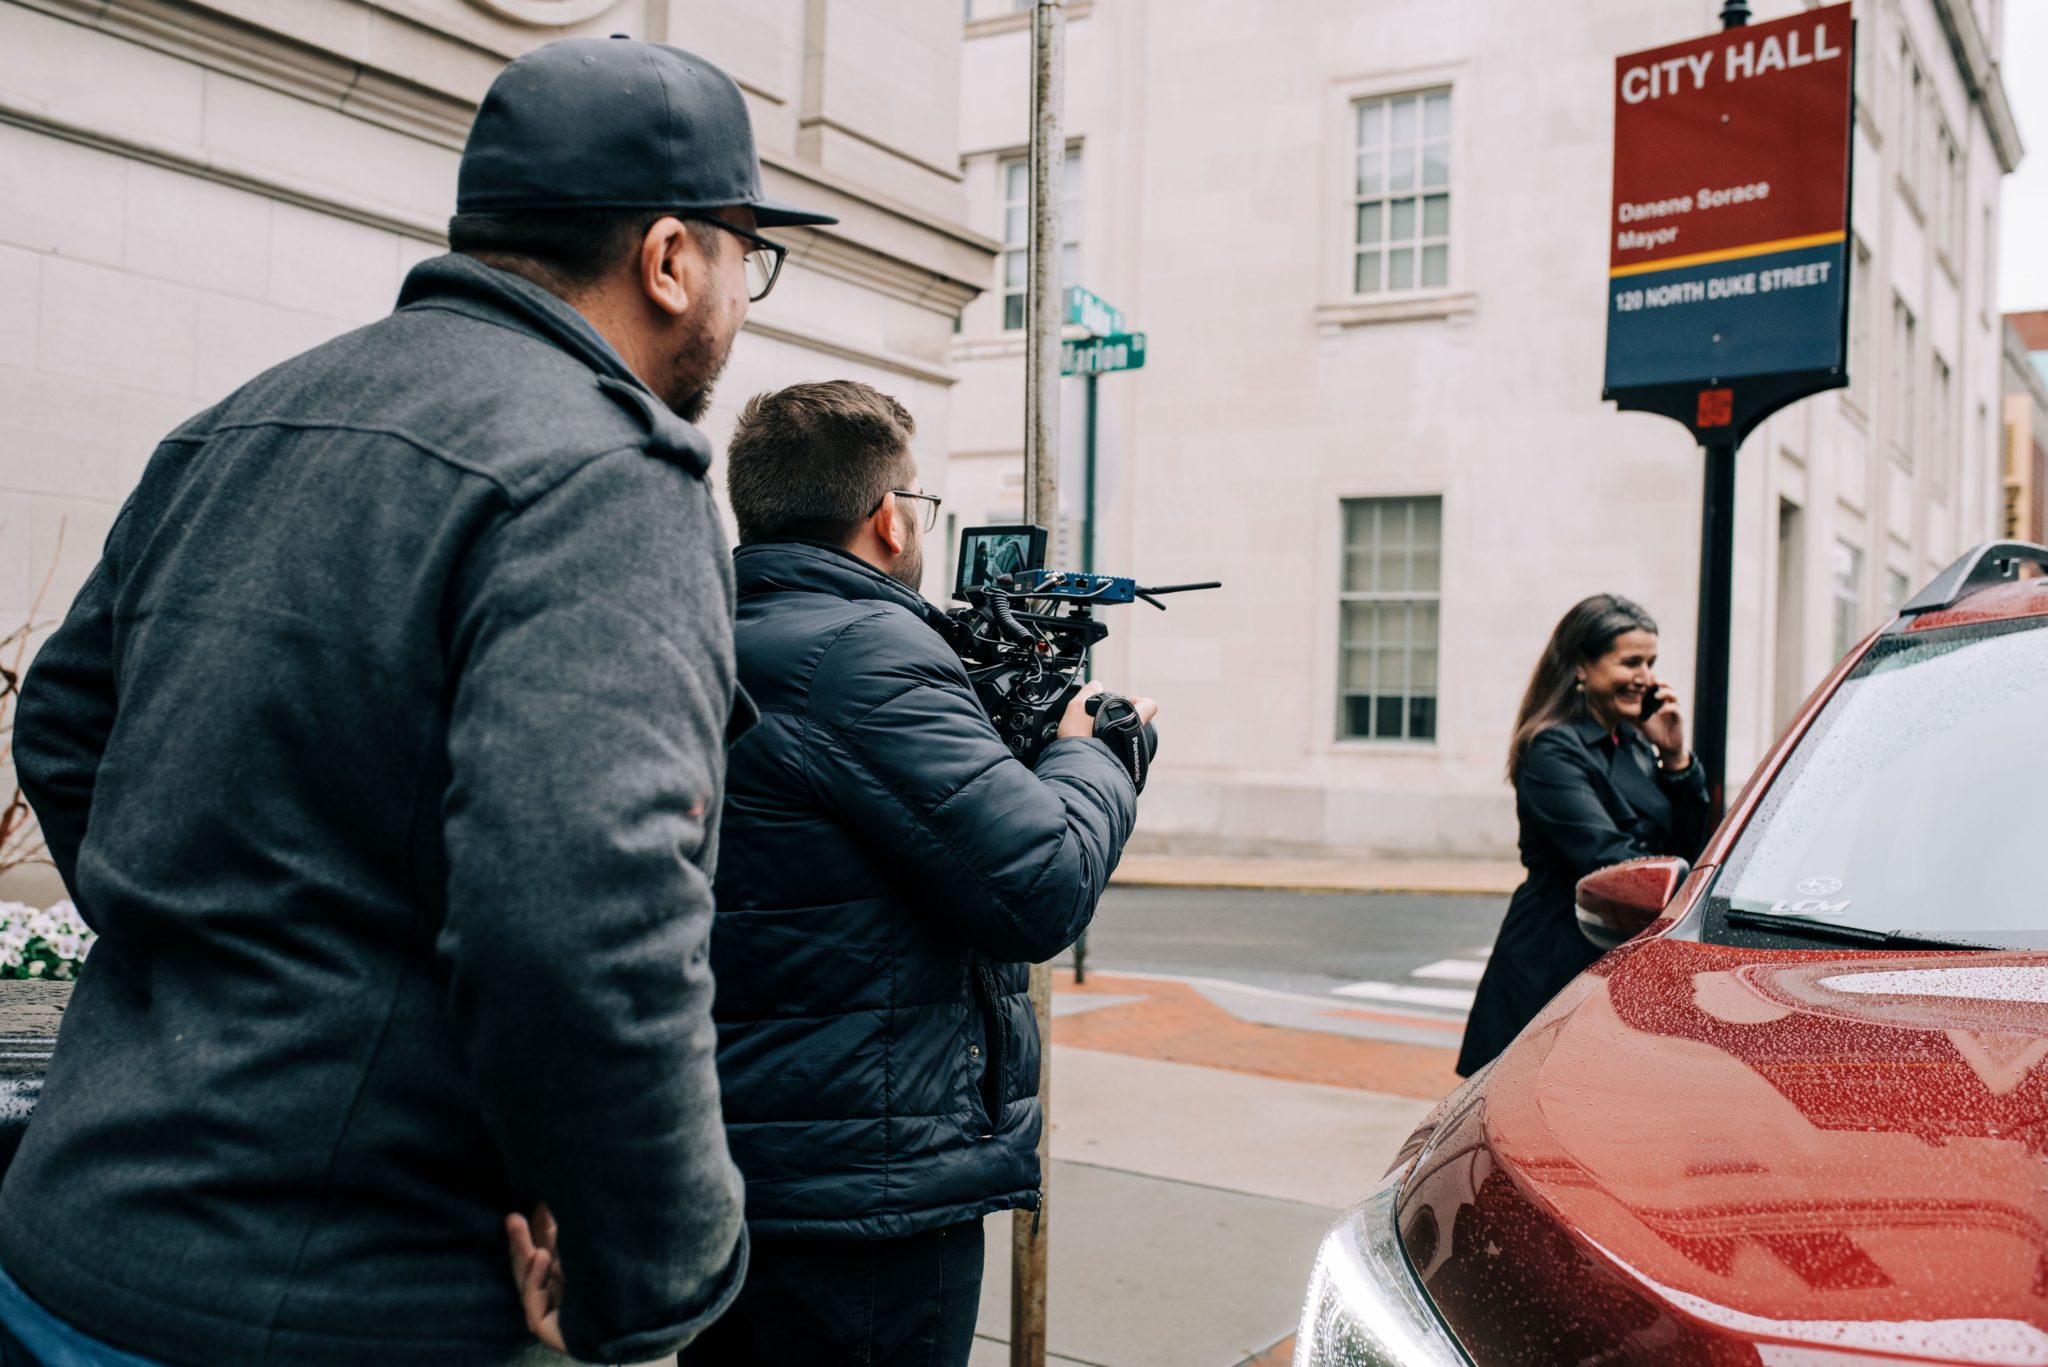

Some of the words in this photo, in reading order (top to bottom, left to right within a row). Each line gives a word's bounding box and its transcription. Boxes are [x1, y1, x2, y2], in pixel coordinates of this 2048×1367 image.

[1621, 50, 1714, 104] CITY
[1725, 23, 1841, 82] HALL
[1618, 195, 1693, 223] Danene
[1696, 181, 1770, 210] Sorace
[1617, 226, 1679, 250] Mayor
[1615, 289, 1643, 312] 120
[1645, 281, 1704, 308] NORTH
[1707, 272, 1756, 300] DUKE
[1759, 261, 1831, 292] STREET
[1131, 735, 1141, 782] Panasonic
[1769, 899, 1852, 913] LCM
